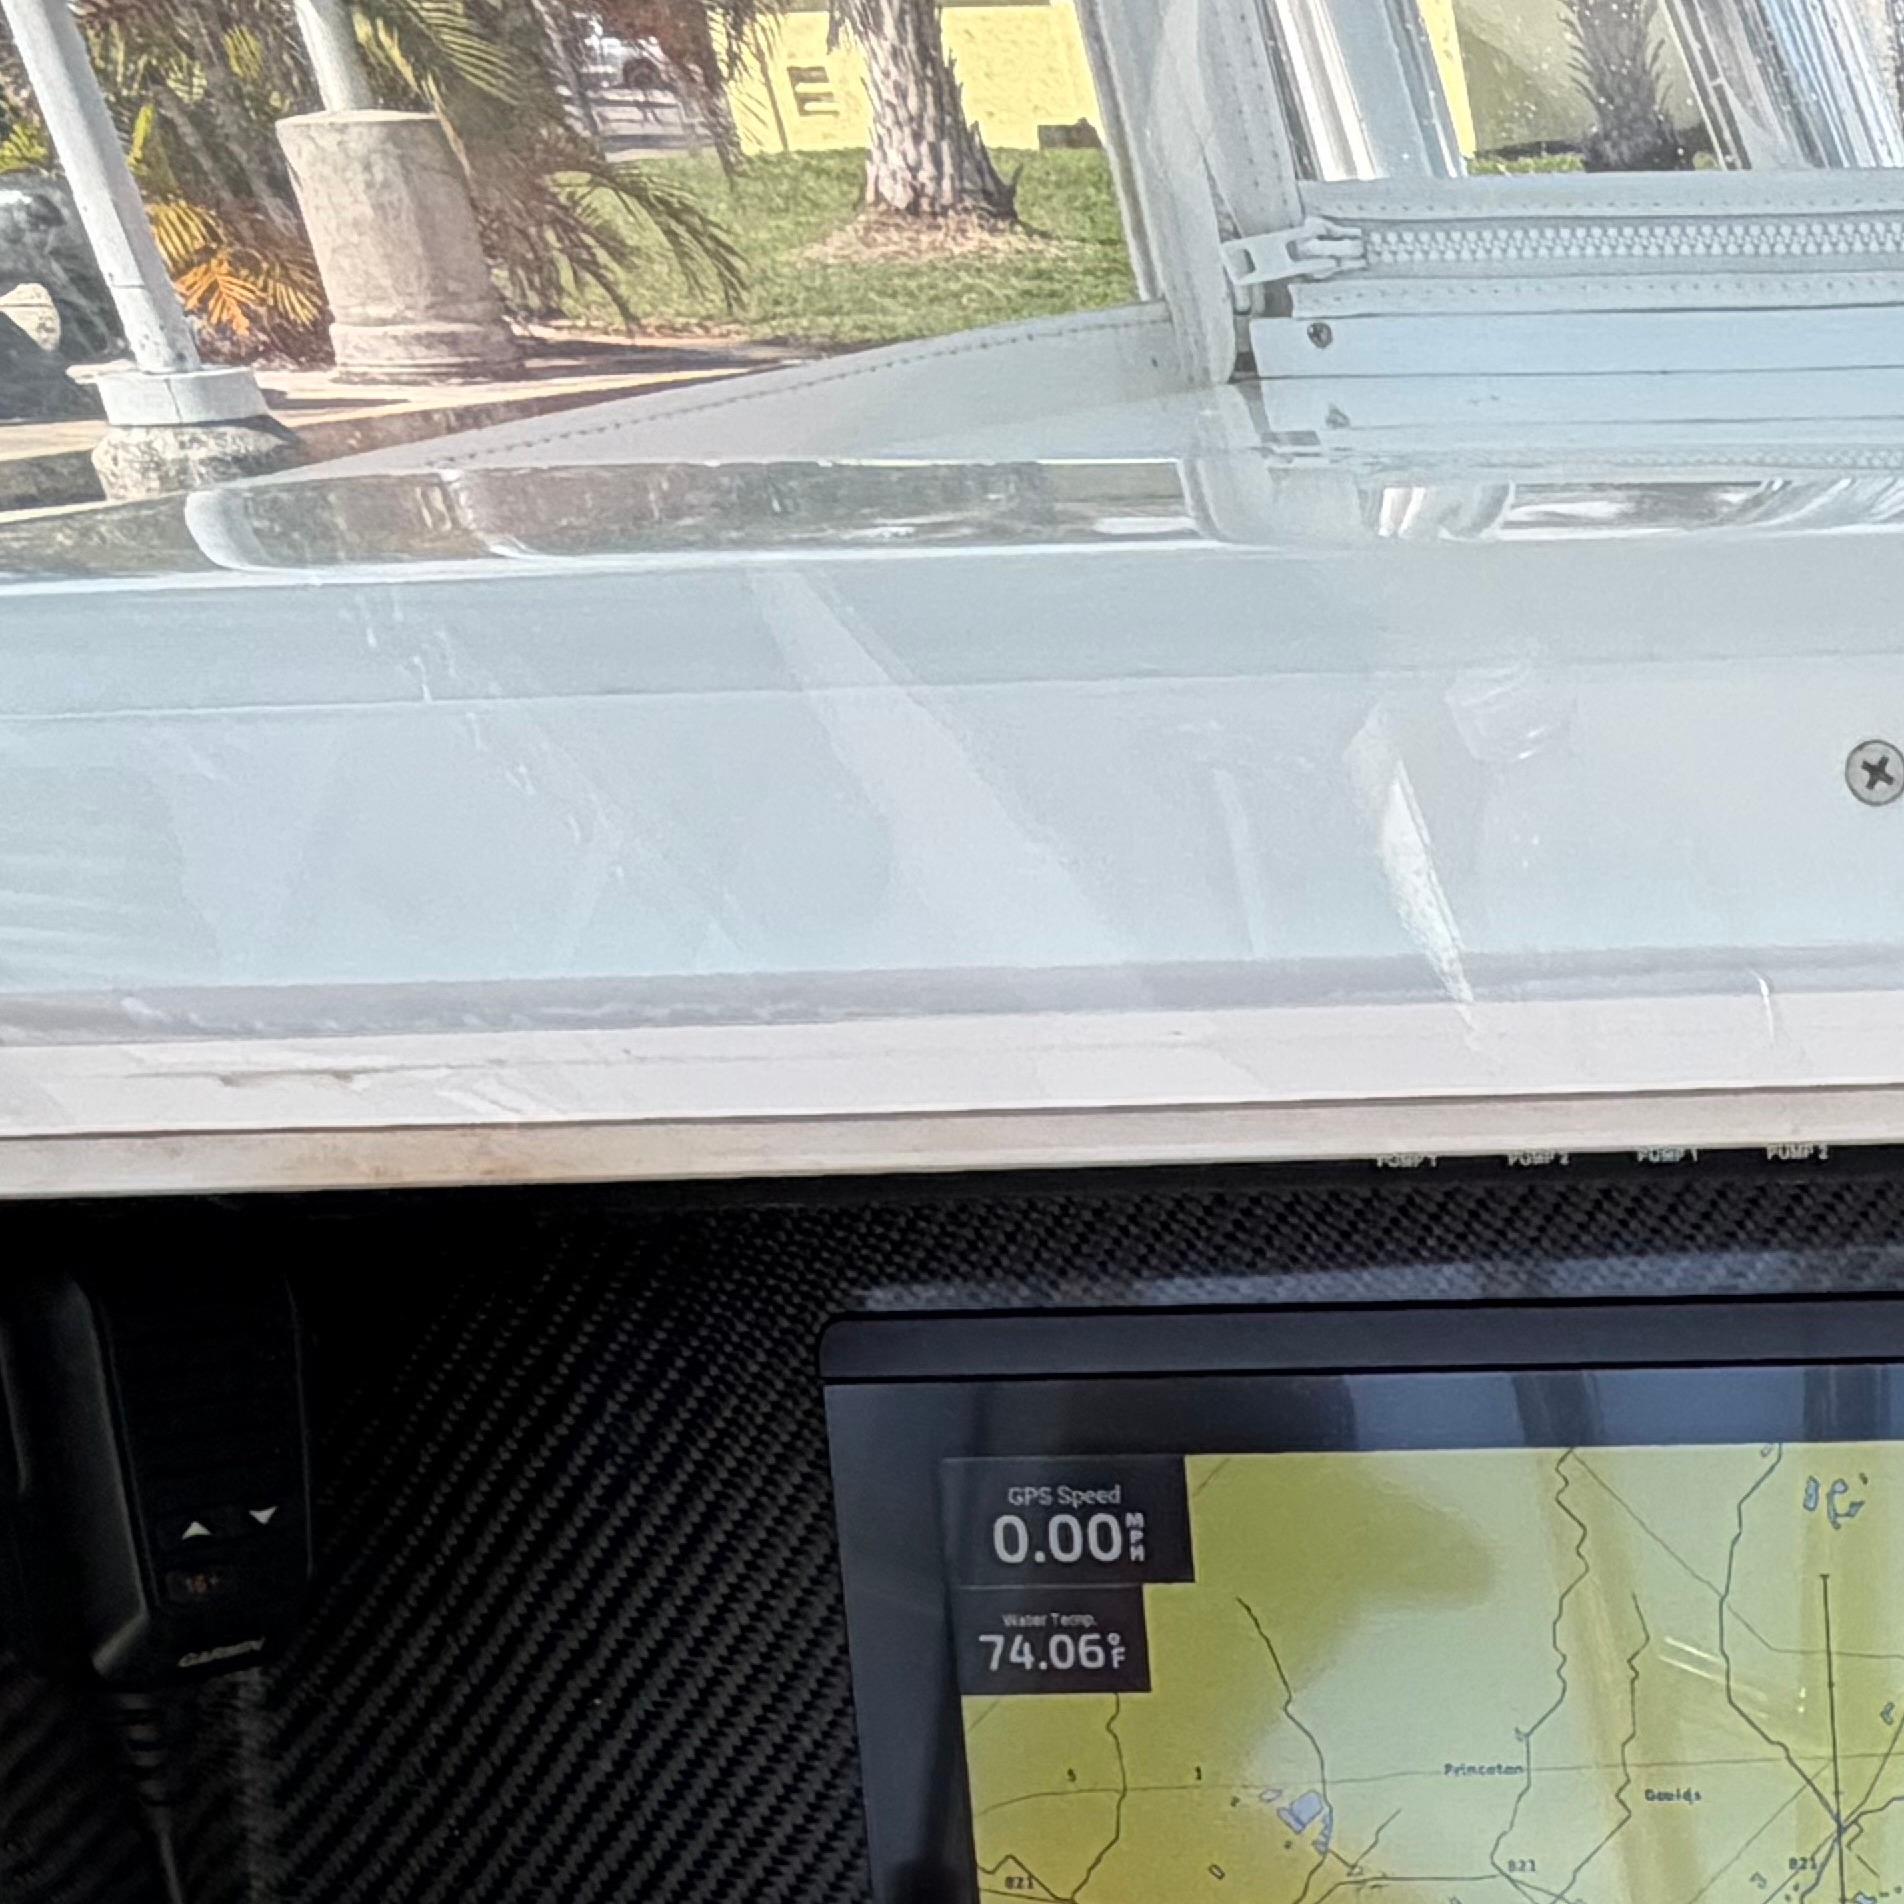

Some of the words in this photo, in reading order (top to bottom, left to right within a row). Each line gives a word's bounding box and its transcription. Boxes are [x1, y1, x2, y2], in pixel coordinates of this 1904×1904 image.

[1008, 1486, 1051, 1506] GPS
[1057, 1484, 1121, 1509] Speed
[993, 1513, 1122, 1563] 0.00
[1003, 1614, 1047, 1628] Water
[1443, 1763, 1524, 1777] Princeton
